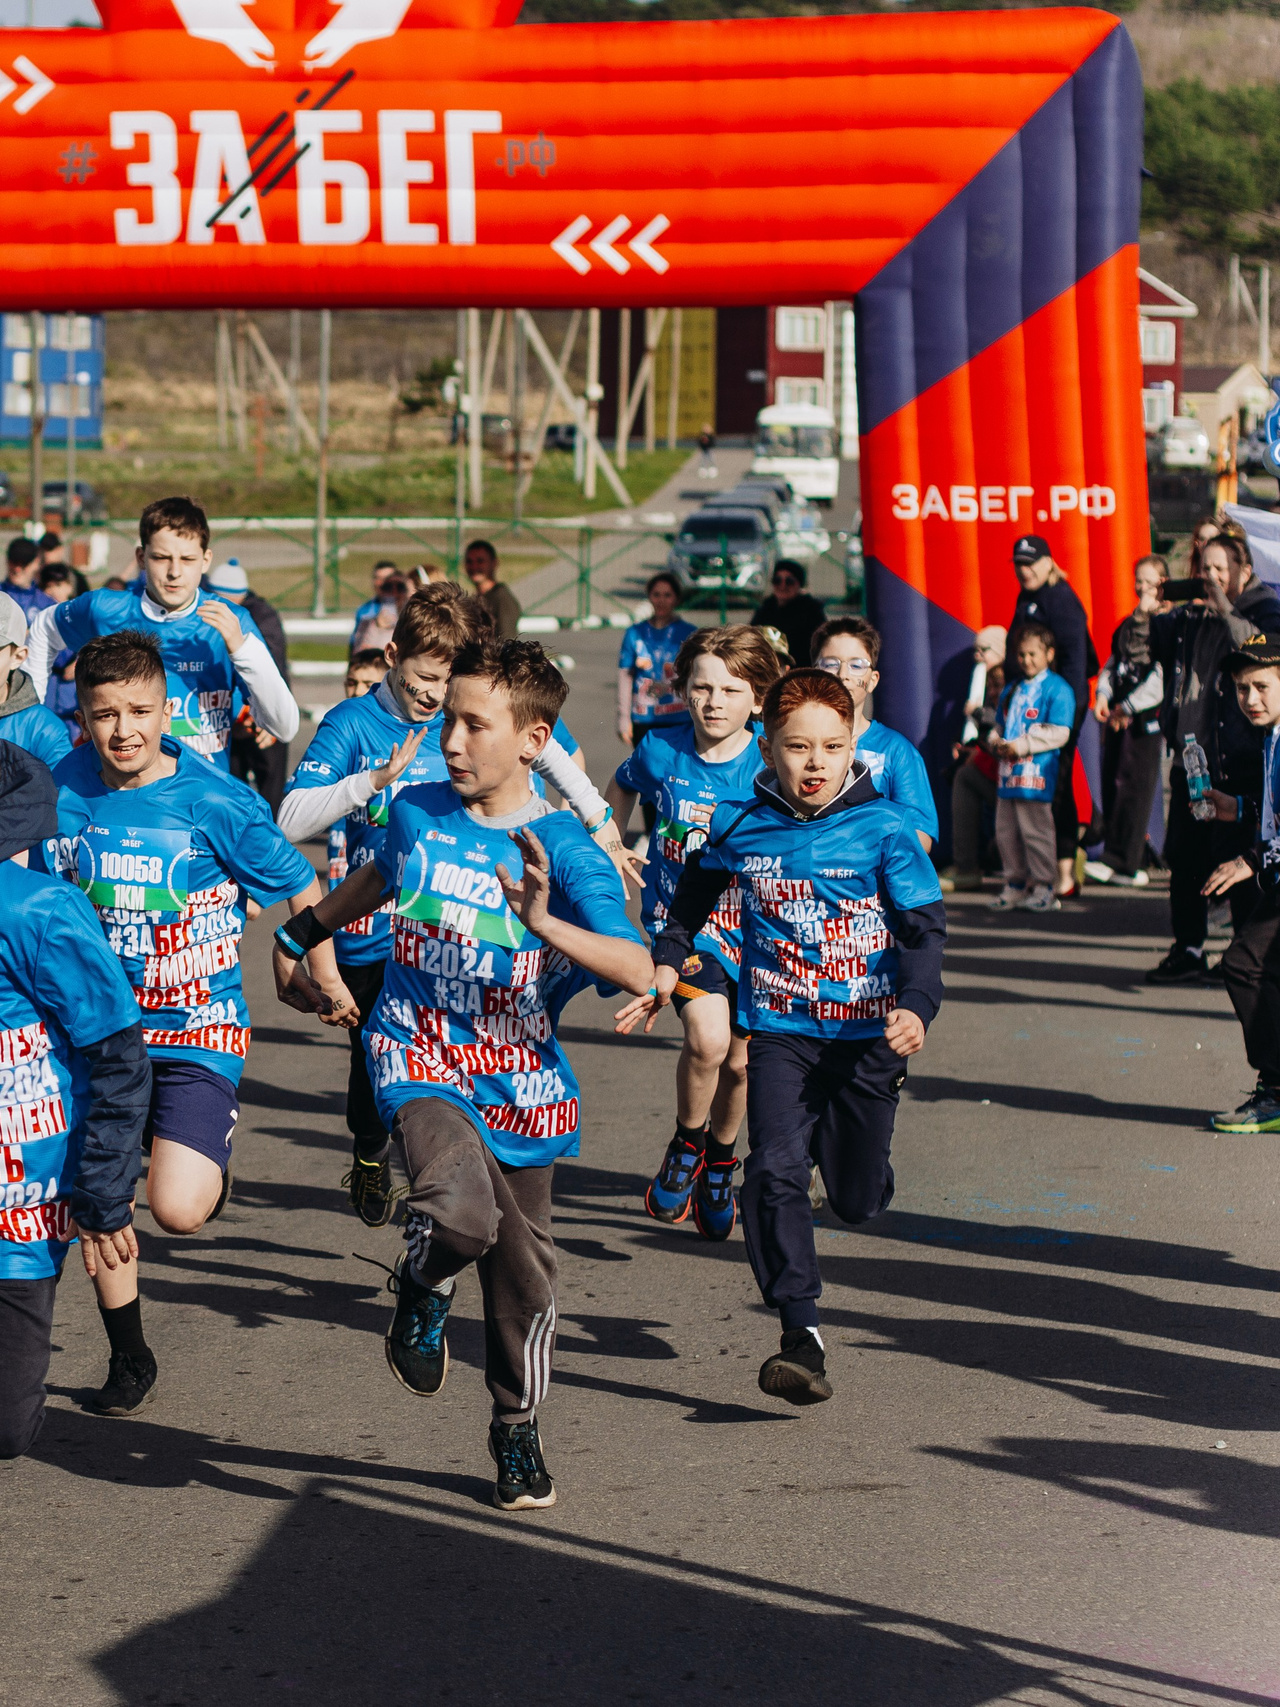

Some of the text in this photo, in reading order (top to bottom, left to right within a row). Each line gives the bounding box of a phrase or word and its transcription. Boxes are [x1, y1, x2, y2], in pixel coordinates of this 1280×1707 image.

[891, 483, 1116, 522] ЗАБЕГ.РФ
[438, 834, 457, 845] ПСБ
[99, 851, 163, 884] 10058
[742, 856, 783, 878] 2024
[430, 861, 503, 910] 10023
[751, 877, 815, 901] #МЕЧТА
[847, 973, 891, 1001] 2024
[512, 1068, 566, 1108] 2024
